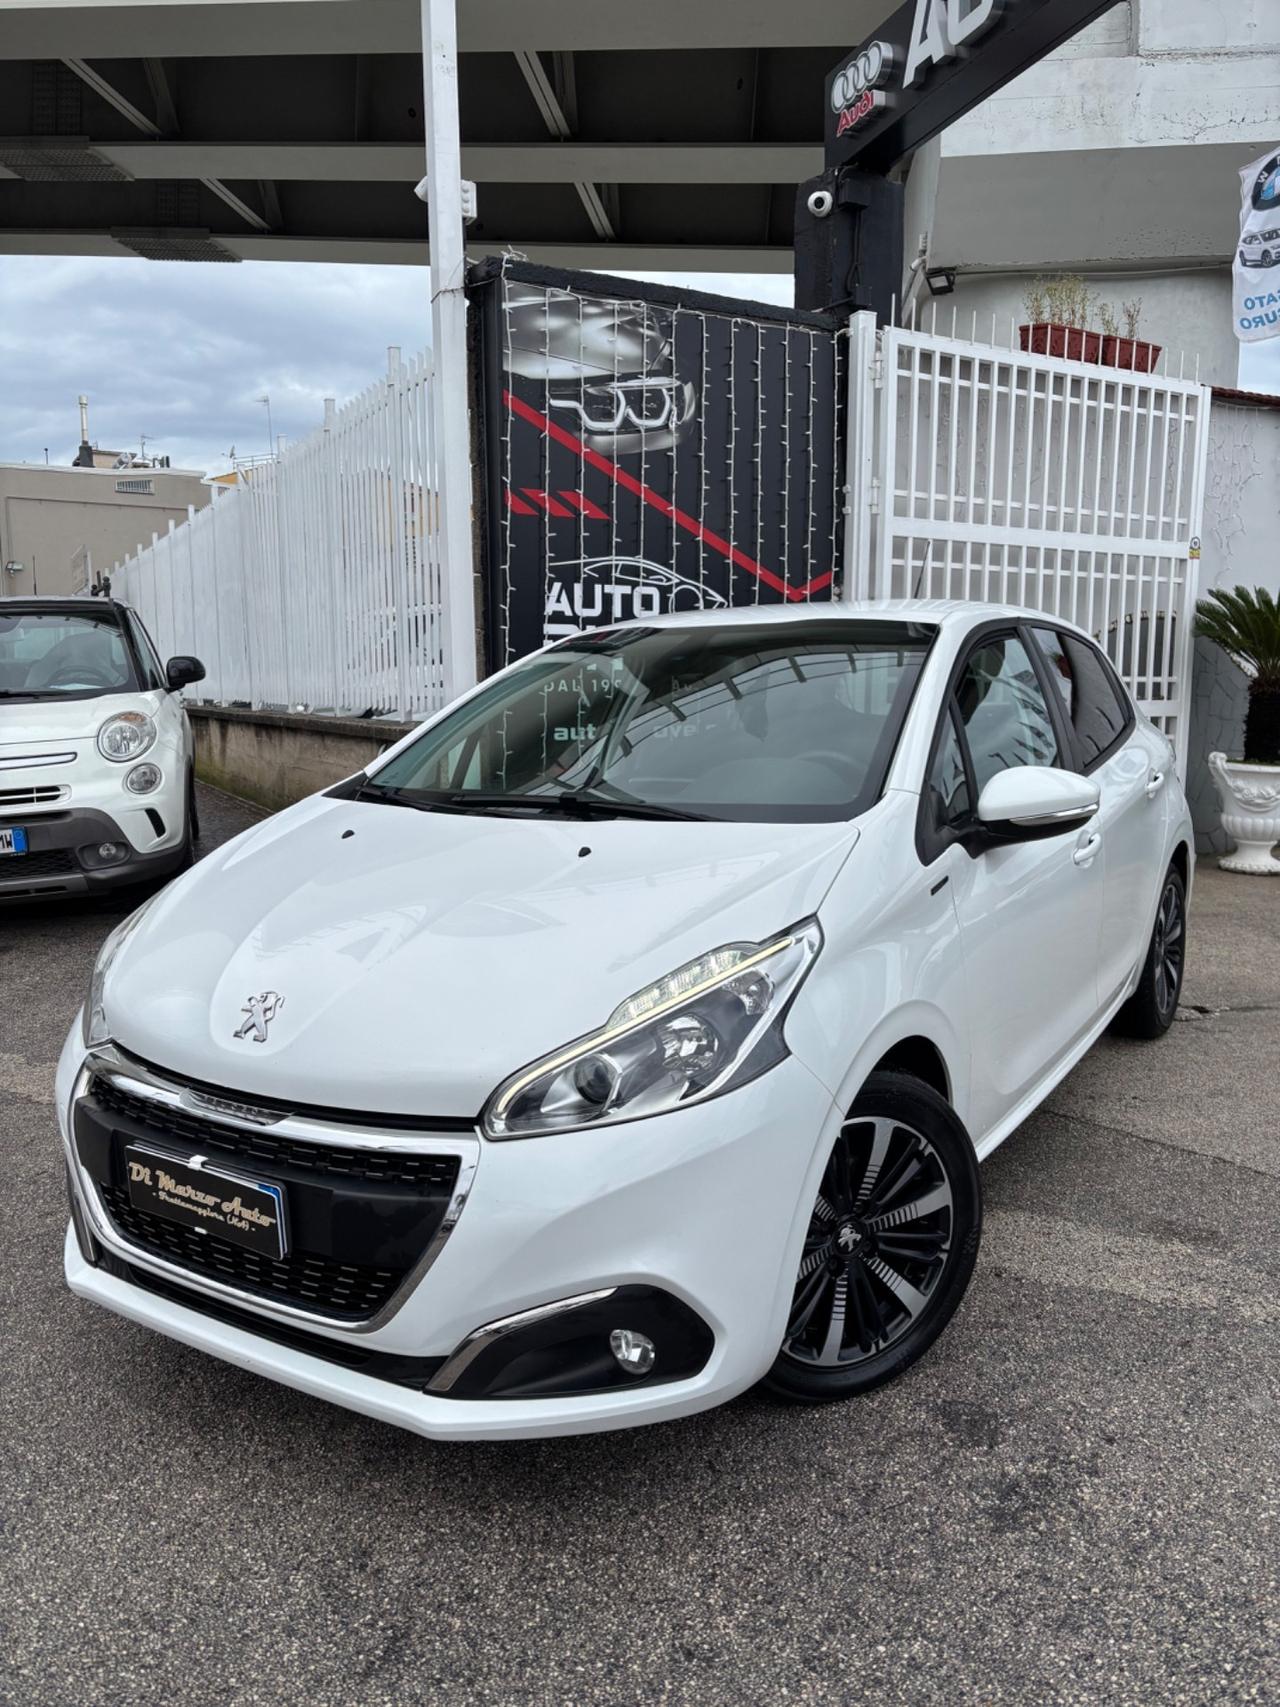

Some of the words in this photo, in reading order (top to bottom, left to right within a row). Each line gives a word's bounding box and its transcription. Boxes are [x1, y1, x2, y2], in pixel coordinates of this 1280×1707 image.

[836, 89, 875, 138] Audi
[544, 582, 660, 619] AUTO
[554, 723, 597, 741] aut
[155, 1170, 221, 1207] Marzo
[221, 1196, 277, 1227] Auto
